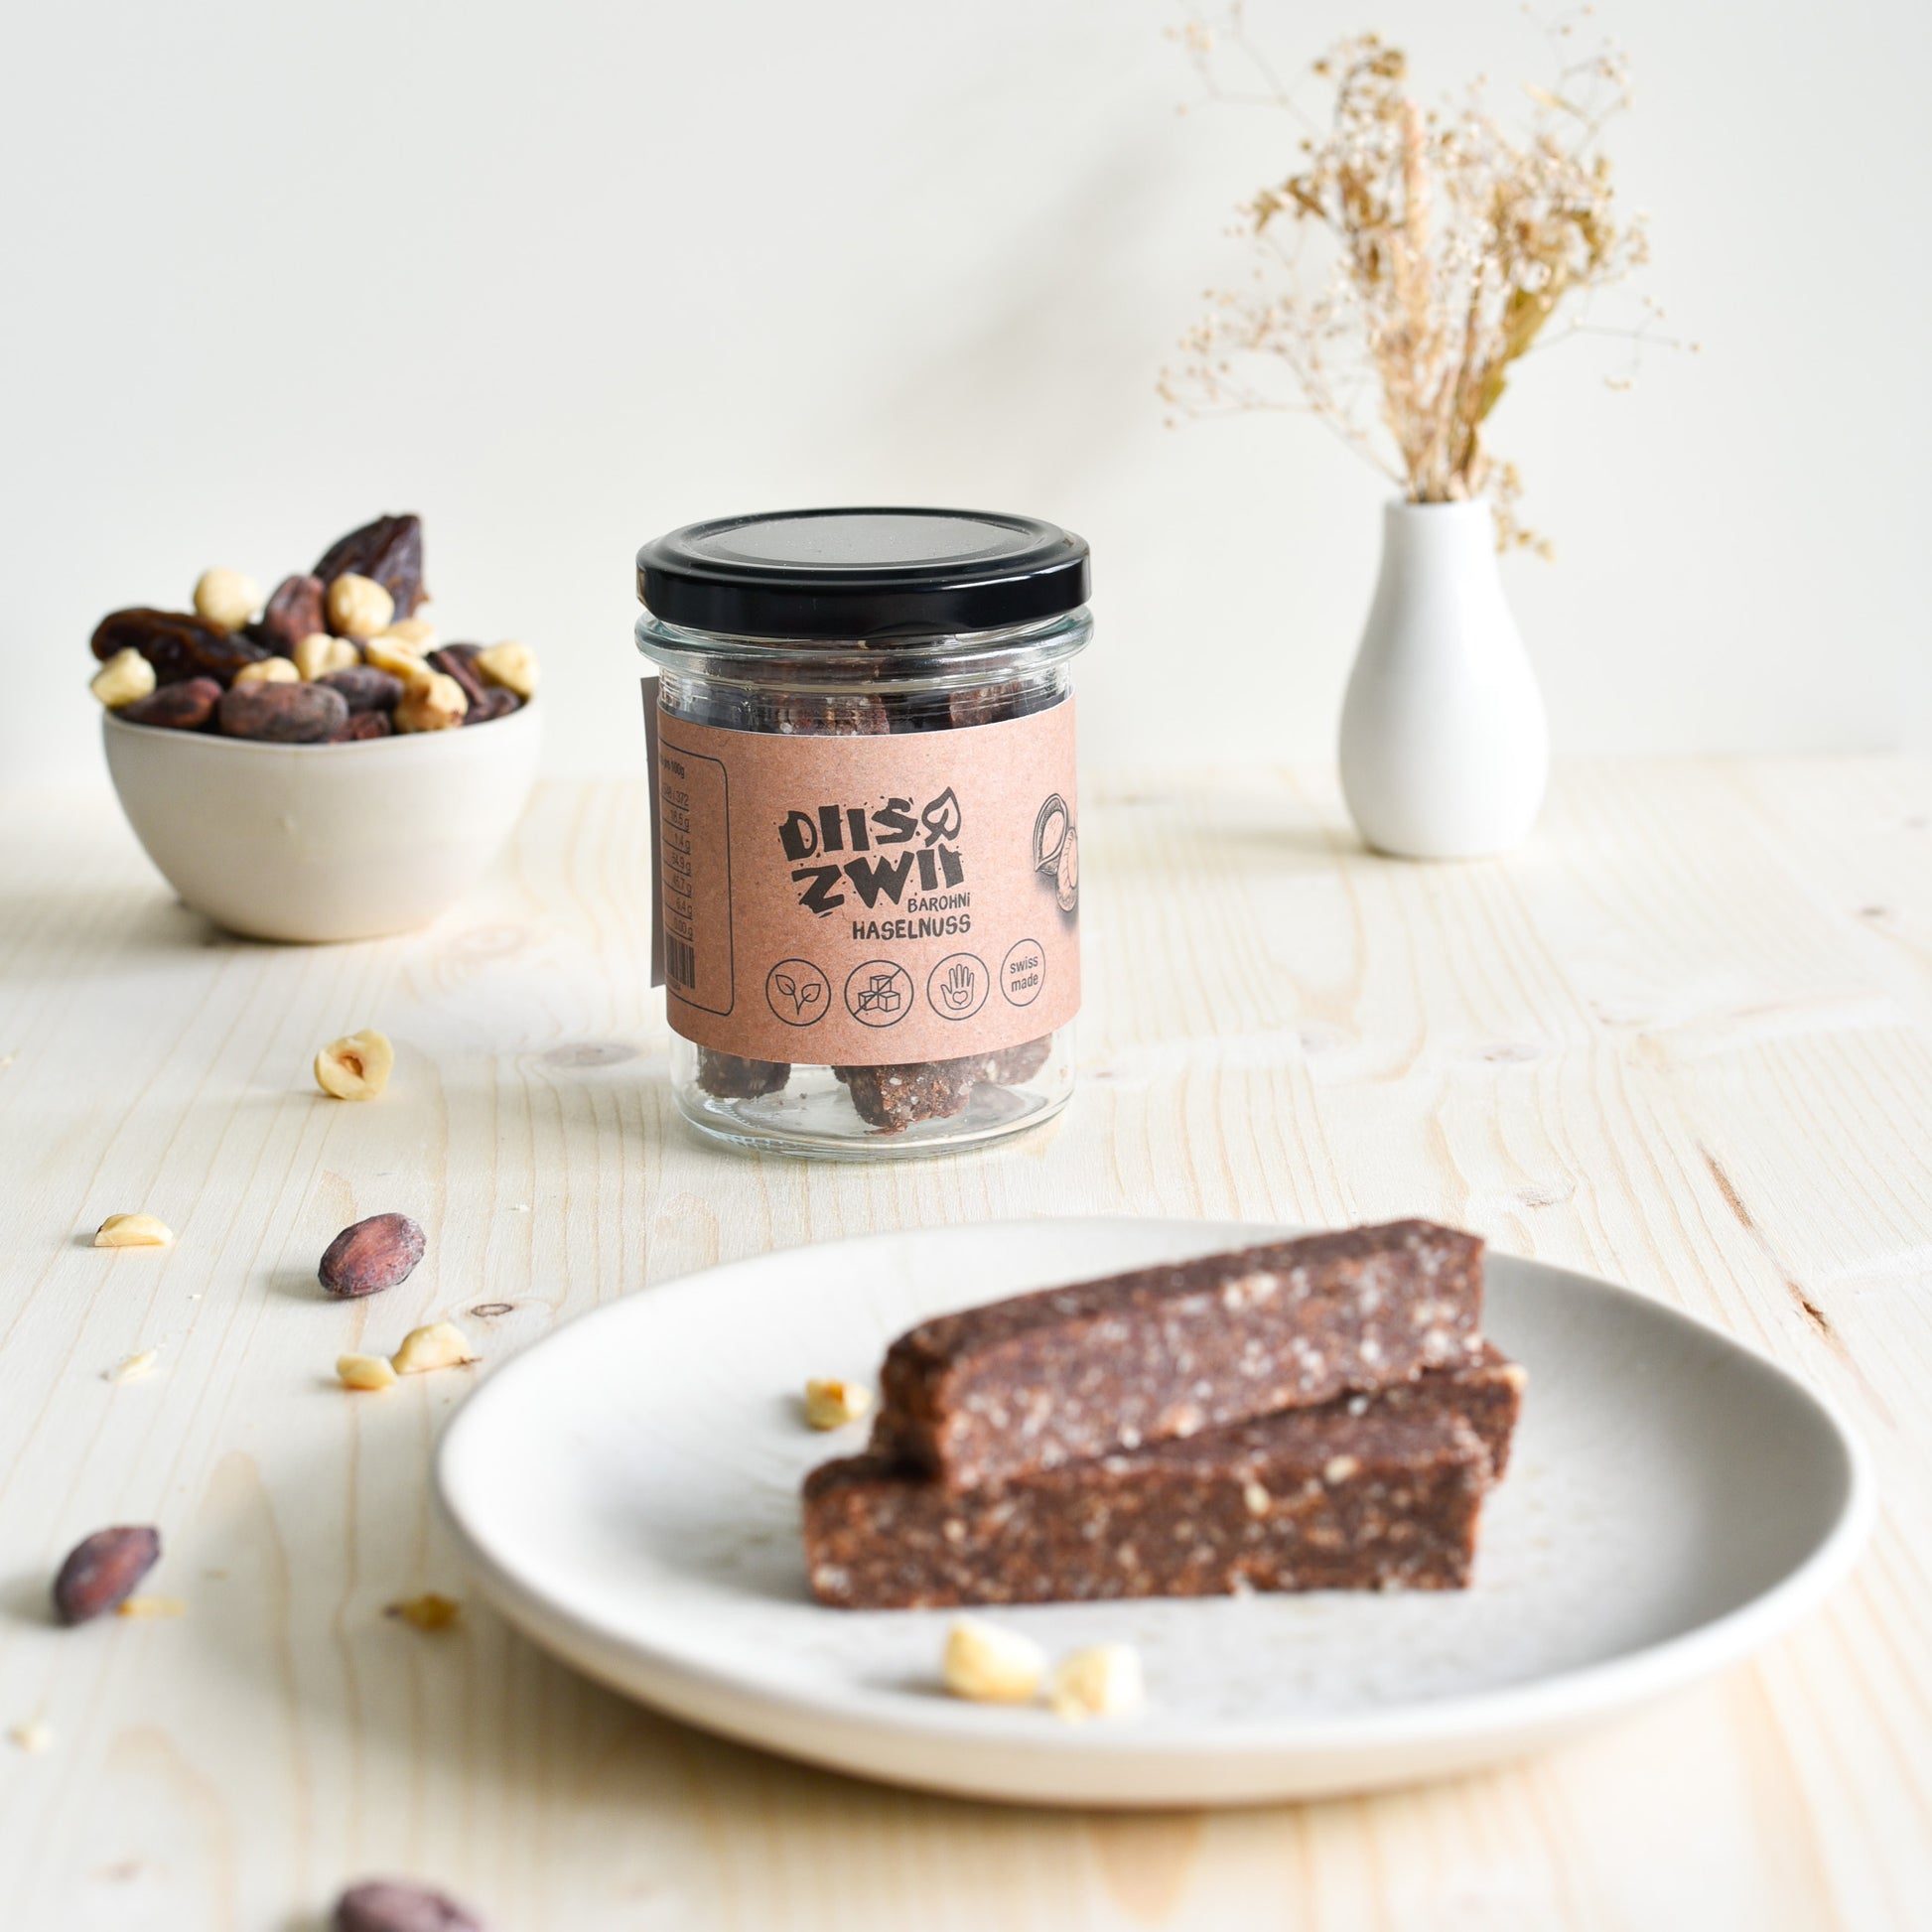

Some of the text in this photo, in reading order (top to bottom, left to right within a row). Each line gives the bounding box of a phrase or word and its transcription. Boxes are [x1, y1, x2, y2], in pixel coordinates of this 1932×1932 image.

[852, 913, 971, 941] HASELNUSS
[1010, 956, 1038, 974] swiss
[1011, 973, 1038, 993] made
